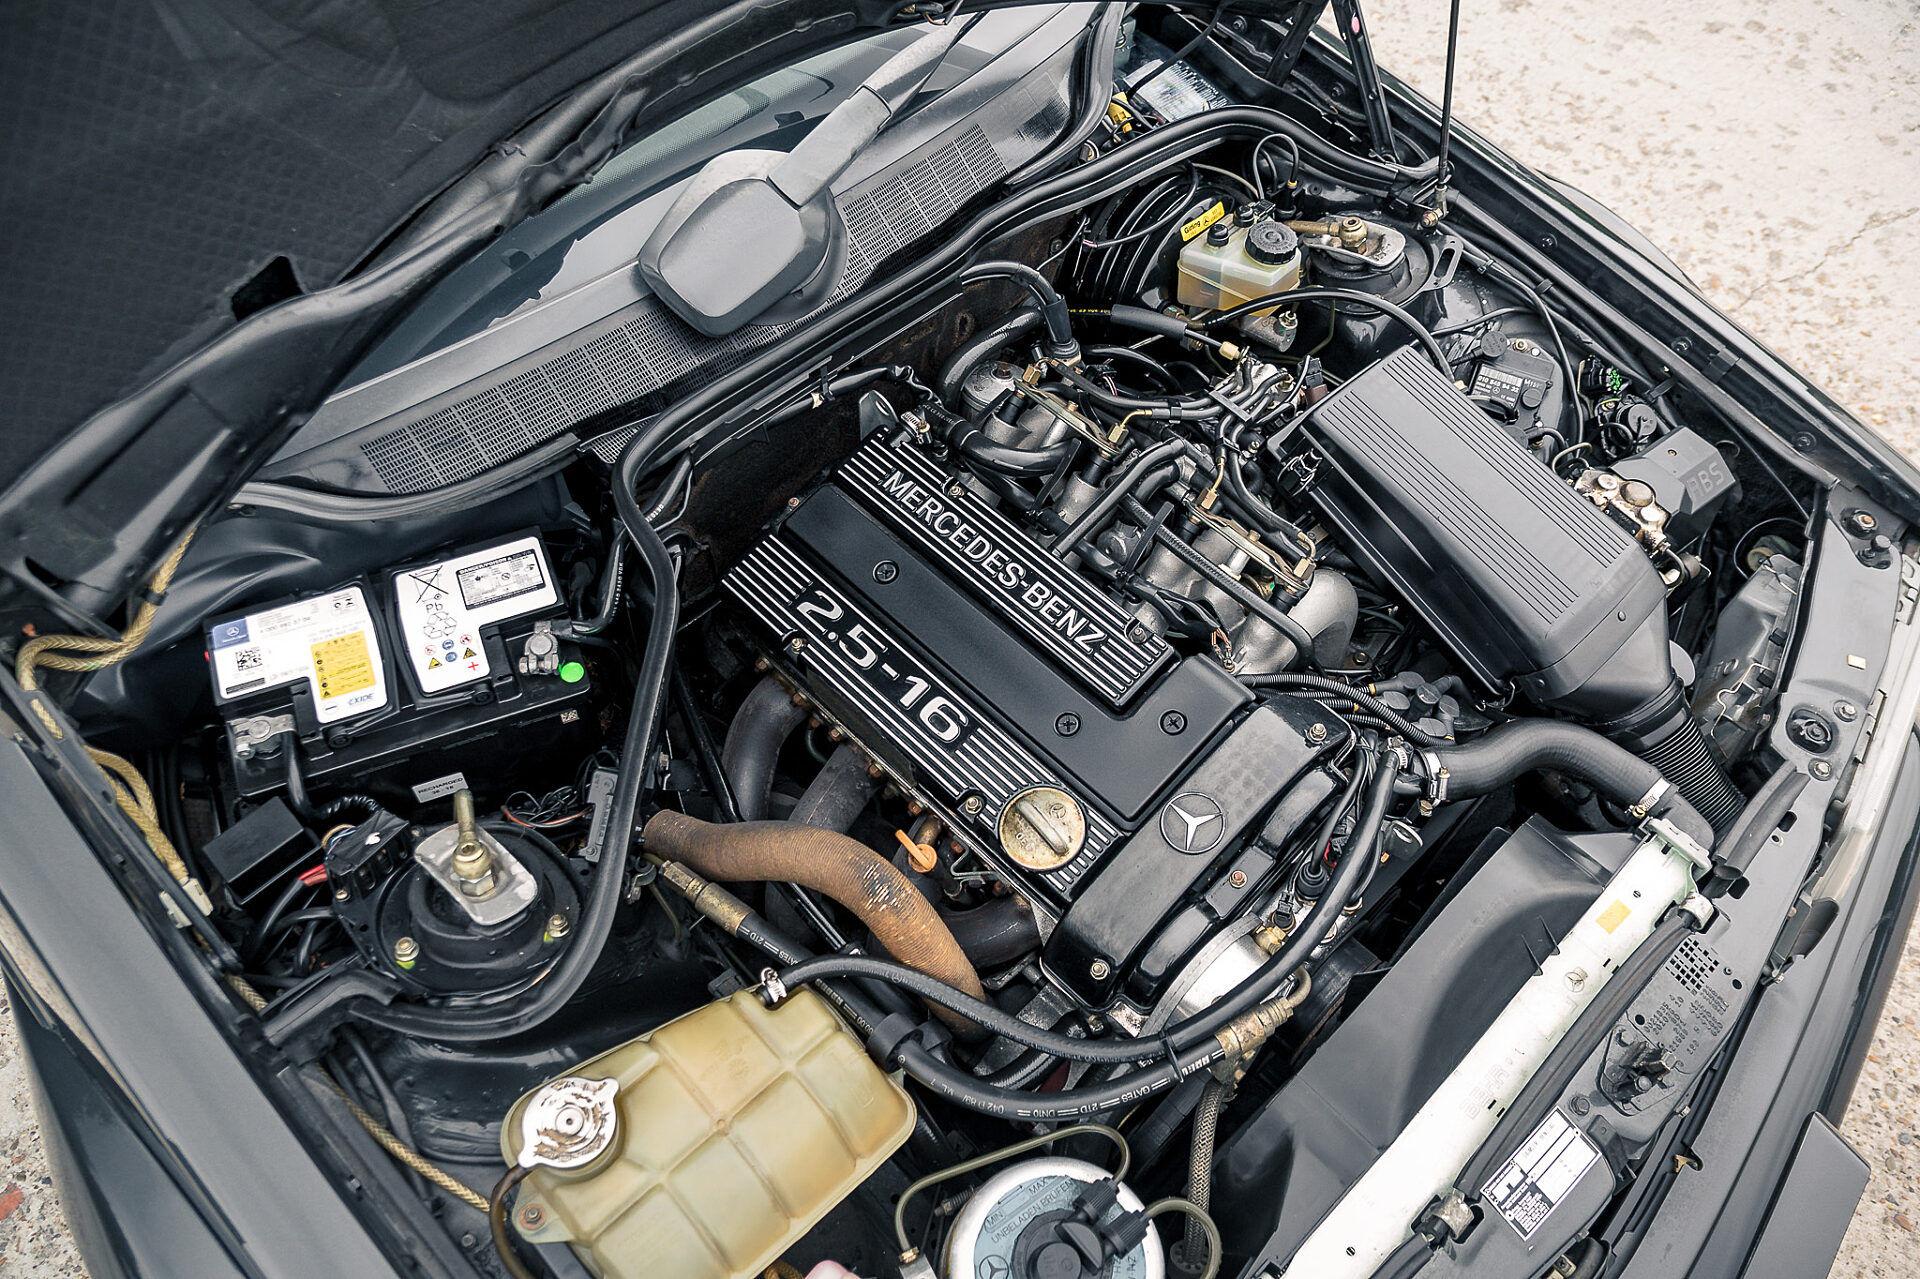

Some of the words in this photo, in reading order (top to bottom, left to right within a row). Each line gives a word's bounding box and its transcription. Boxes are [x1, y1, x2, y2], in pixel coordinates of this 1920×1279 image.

[1686, 462, 1724, 497] ABS
[880, 469, 1107, 654] MERCEDES-BENZ
[426, 600, 444, 614] Pb
[797, 590, 969, 742] 2.5-16
[348, 692, 375, 705] EXIDE
[778, 951, 799, 966] ATES
[1121, 1085, 1151, 1103] GATES
[1033, 1109, 1056, 1118] DN10
[1080, 1102, 1099, 1114] 2TD
[1028, 1178, 1049, 1196] MAX
[986, 1210, 1004, 1227] MIN
[991, 1203, 1042, 1244] UNBELADEN
